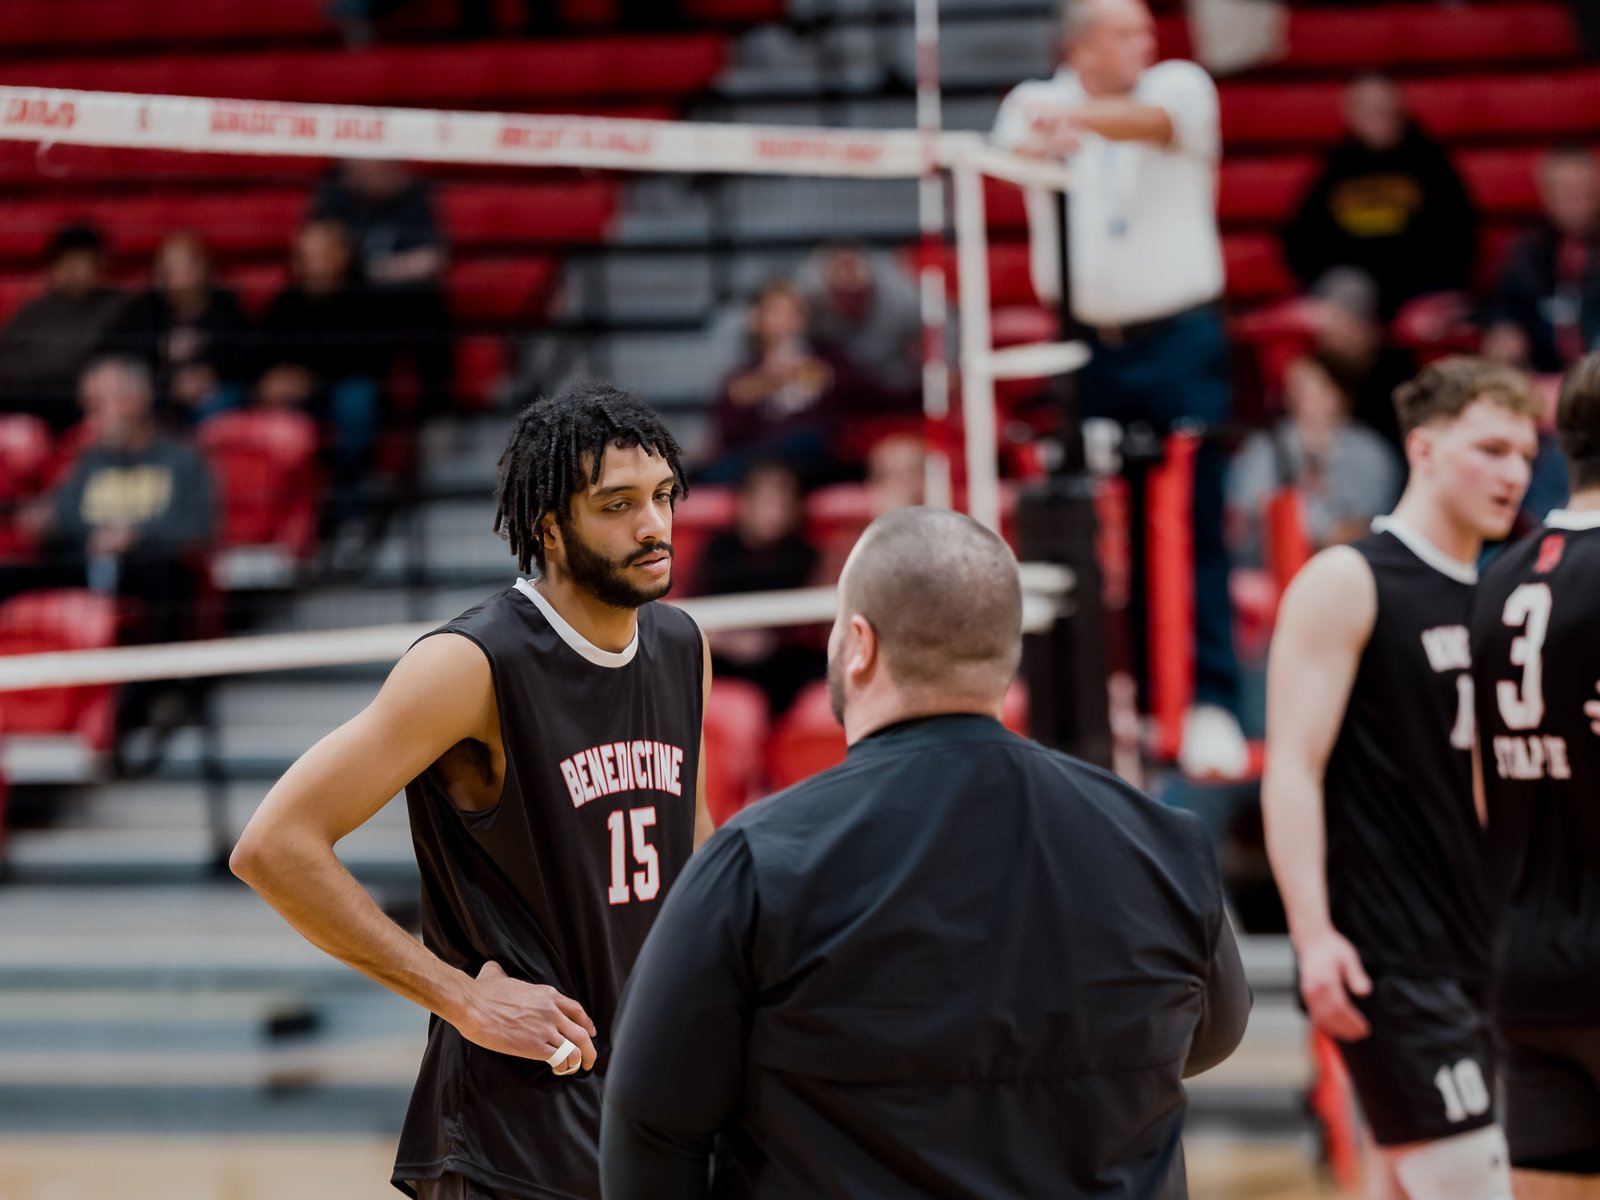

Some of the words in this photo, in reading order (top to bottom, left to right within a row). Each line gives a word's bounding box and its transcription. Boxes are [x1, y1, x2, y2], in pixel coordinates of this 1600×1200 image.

[1496, 582, 1552, 730] 3
[559, 740, 684, 809] BENEDICTINE
[607, 806, 661, 906] 15
[1433, 1057, 1491, 1123] 10
